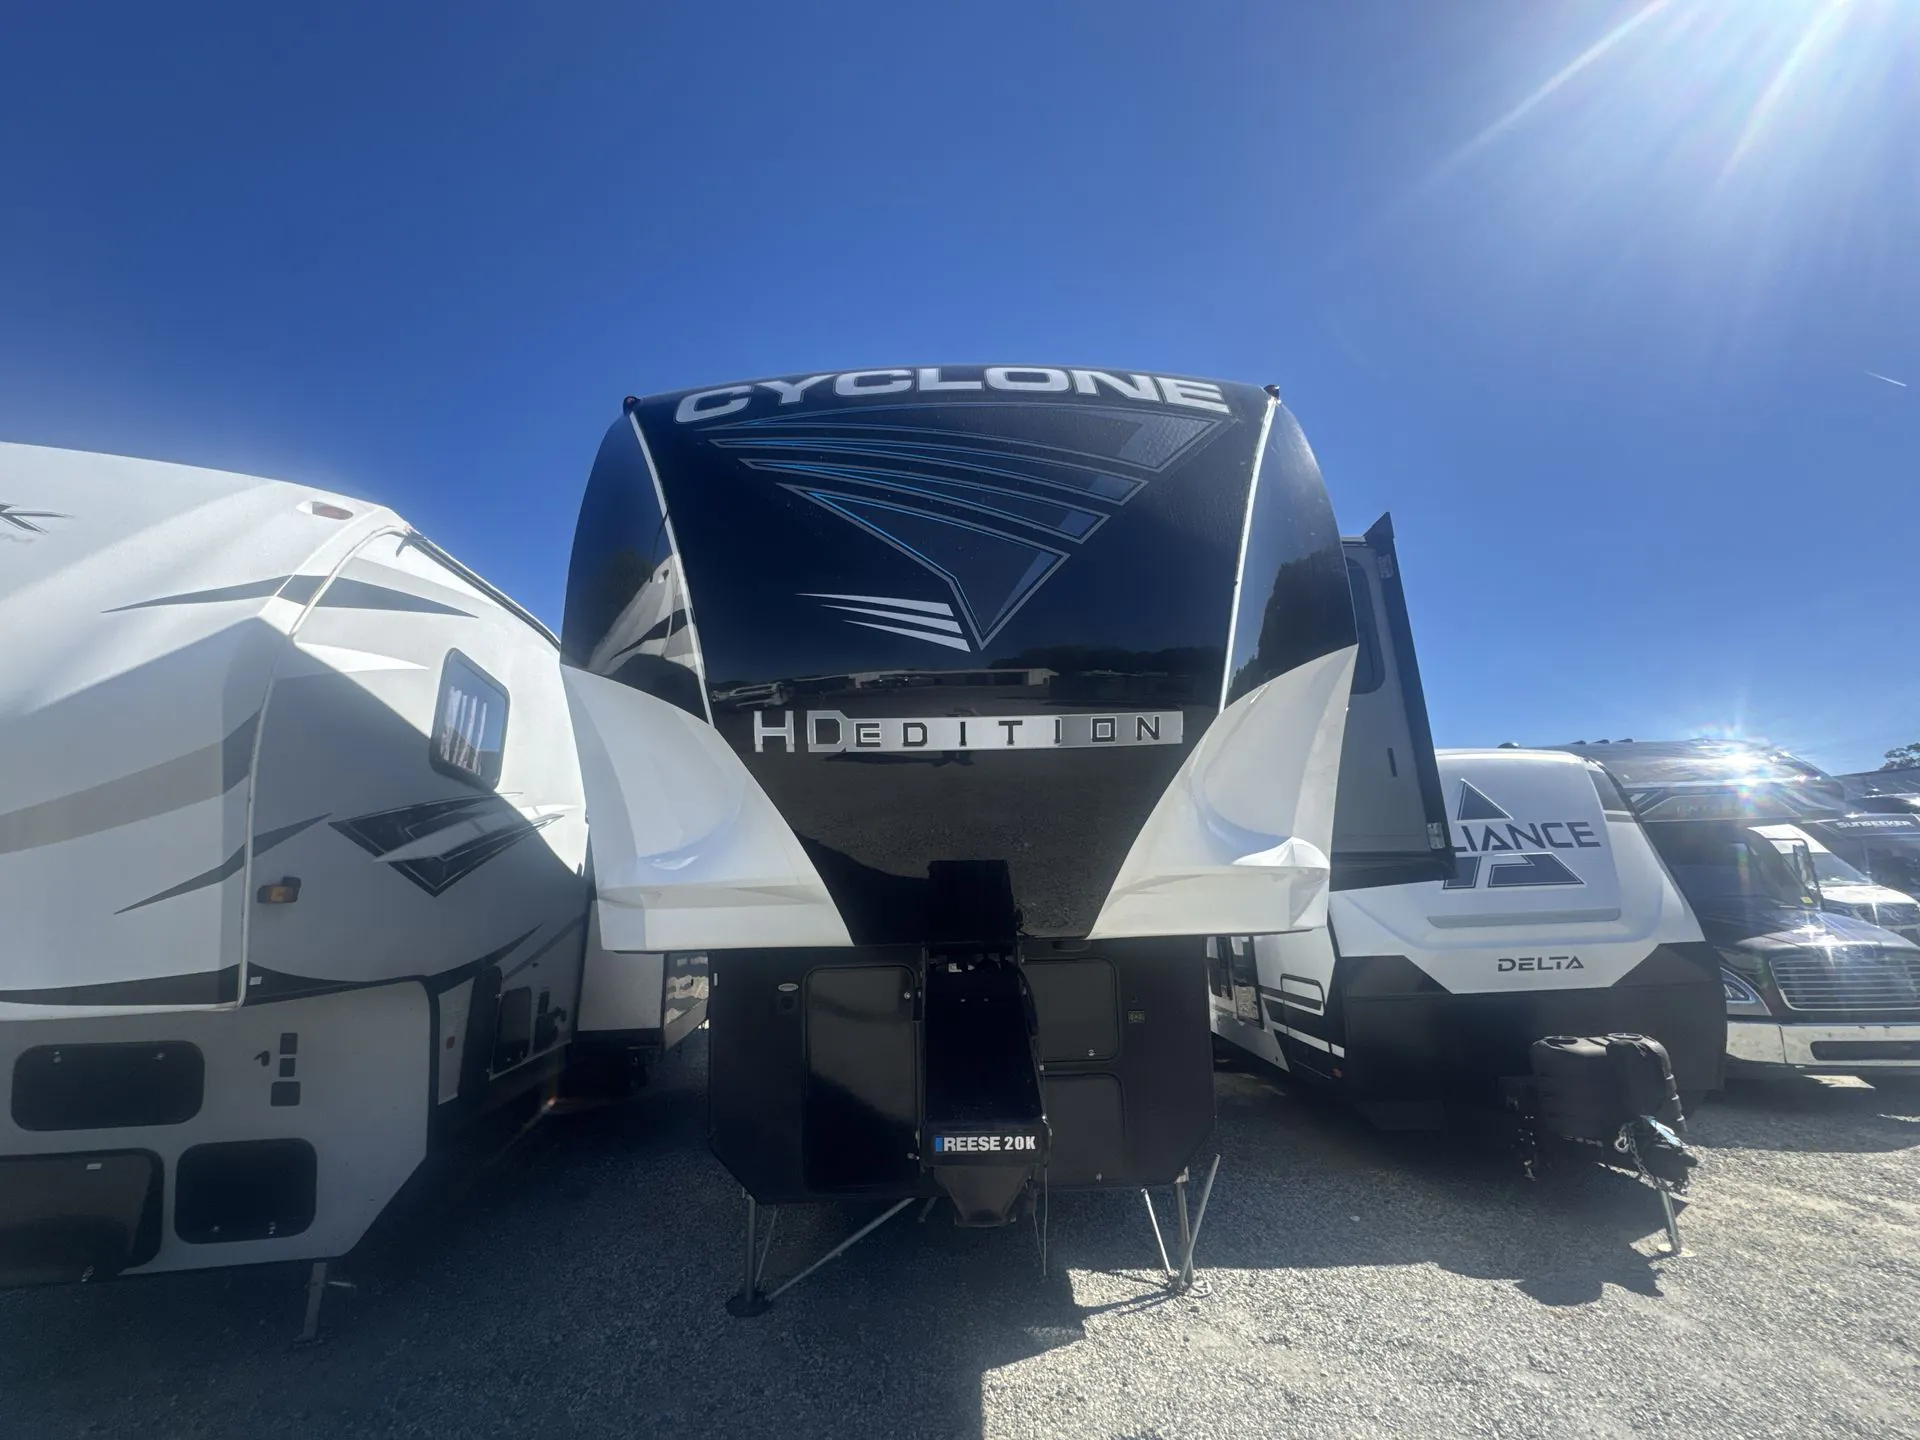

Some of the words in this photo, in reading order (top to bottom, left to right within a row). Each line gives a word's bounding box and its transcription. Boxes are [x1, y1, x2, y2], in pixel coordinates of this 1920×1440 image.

[673, 365, 1233, 425] CYCLONE
[752, 709, 847, 753] HD
[855, 715, 1161, 748] EDITION
[1497, 955, 1585, 972] DELTA
[943, 1136, 1001, 1152] REESE
[1004, 1136, 1036, 1150] 20K
